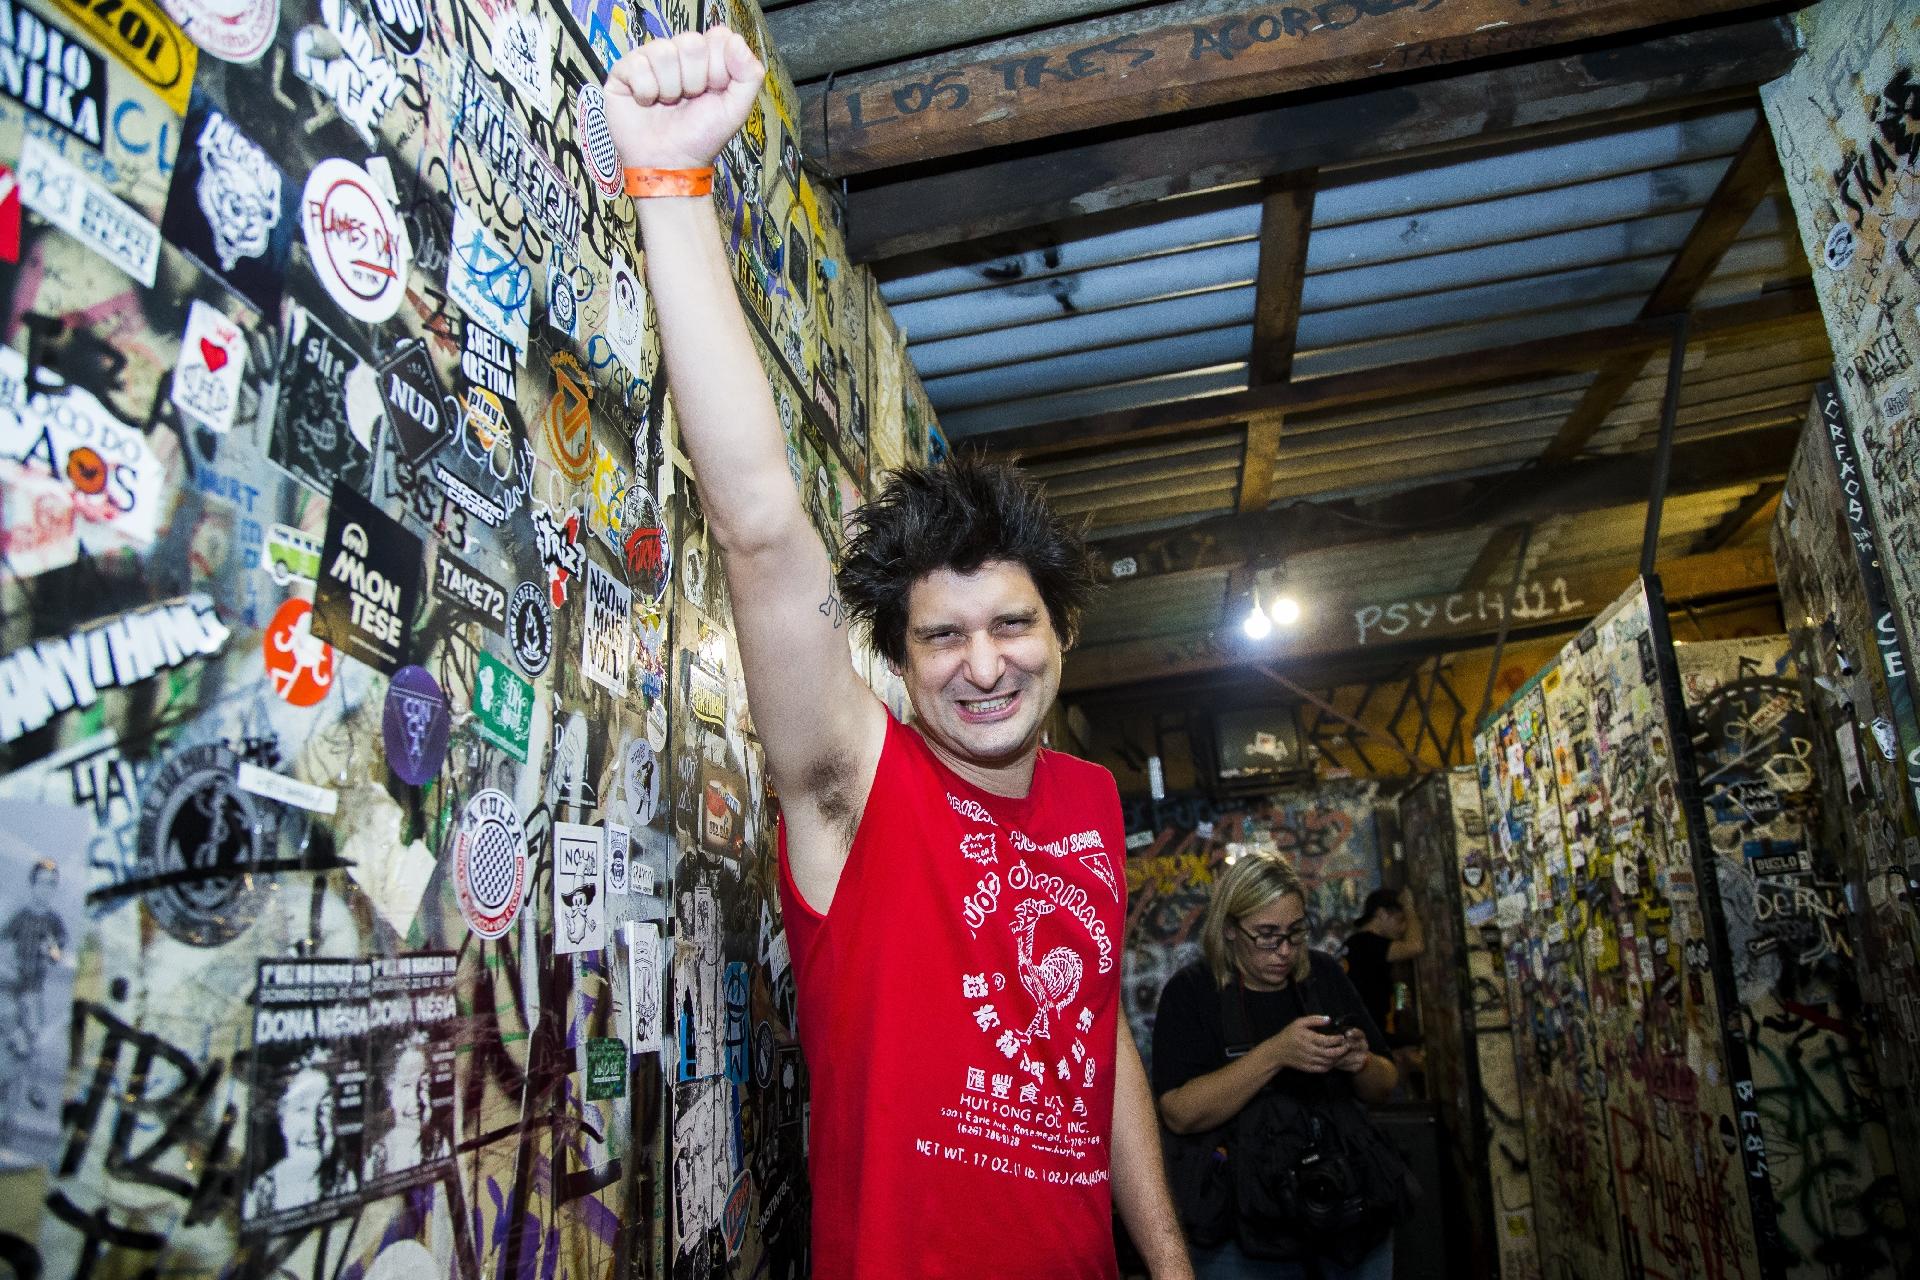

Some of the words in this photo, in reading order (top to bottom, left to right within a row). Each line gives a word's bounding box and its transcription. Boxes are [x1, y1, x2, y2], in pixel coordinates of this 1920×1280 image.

[847, 70, 970, 129] LOS
[466, 322, 513, 373] SHEILA
[389, 373, 439, 433] NUD
[468, 391, 499, 428] play
[329, 550, 401, 616] MON
[439, 557, 506, 623] TAKE72
[350, 591, 403, 650] TESE
[916, 1138, 940, 1156] NET
[944, 1147, 968, 1164] WT.
[973, 1152, 988, 1168] 17
